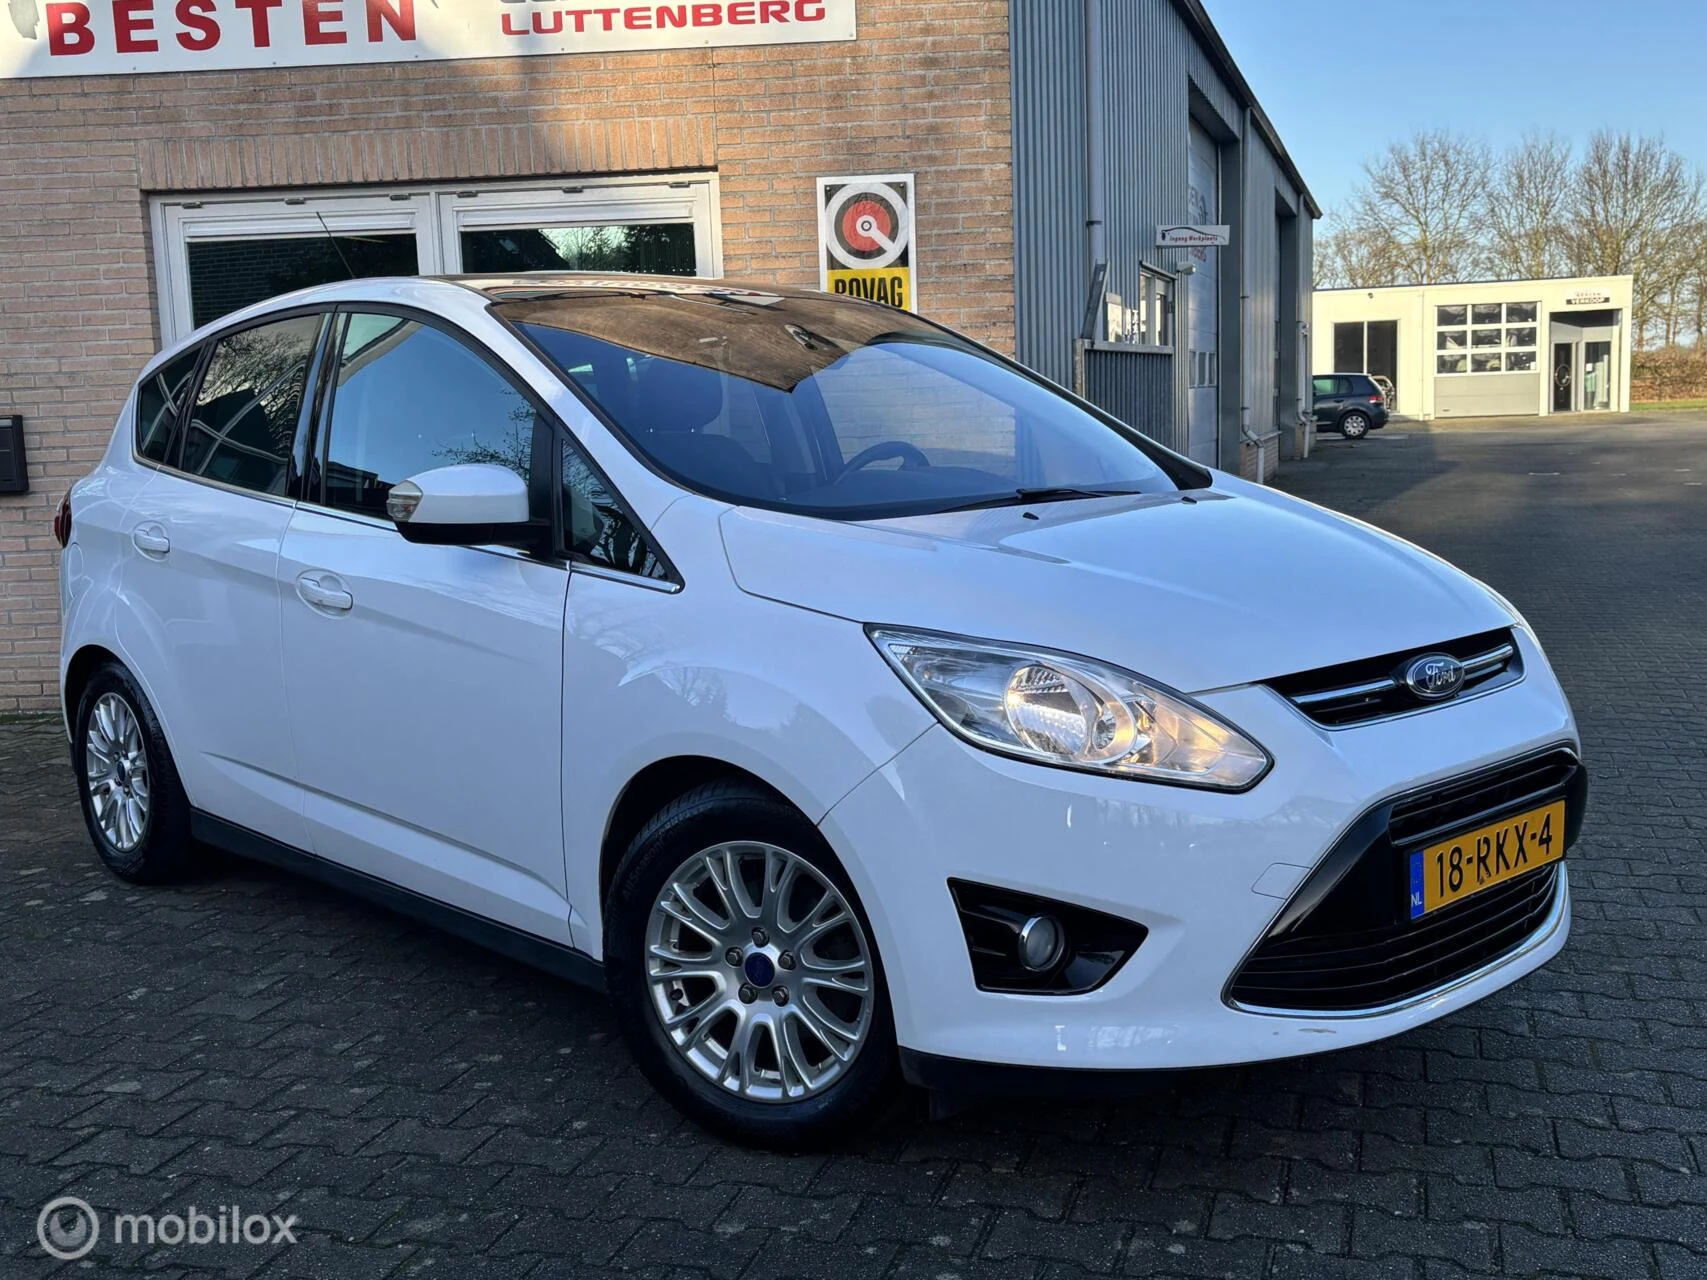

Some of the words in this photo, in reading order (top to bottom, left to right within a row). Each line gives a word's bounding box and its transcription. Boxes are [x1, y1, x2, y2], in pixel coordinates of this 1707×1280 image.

[46, 0, 417, 56] BESTEN
[501, 0, 826, 36] LUTTENBERG
[1425, 662, 1456, 690] Ford
[1436, 812, 1553, 899] 18-RKX-4
[1411, 893, 1423, 908] NL
